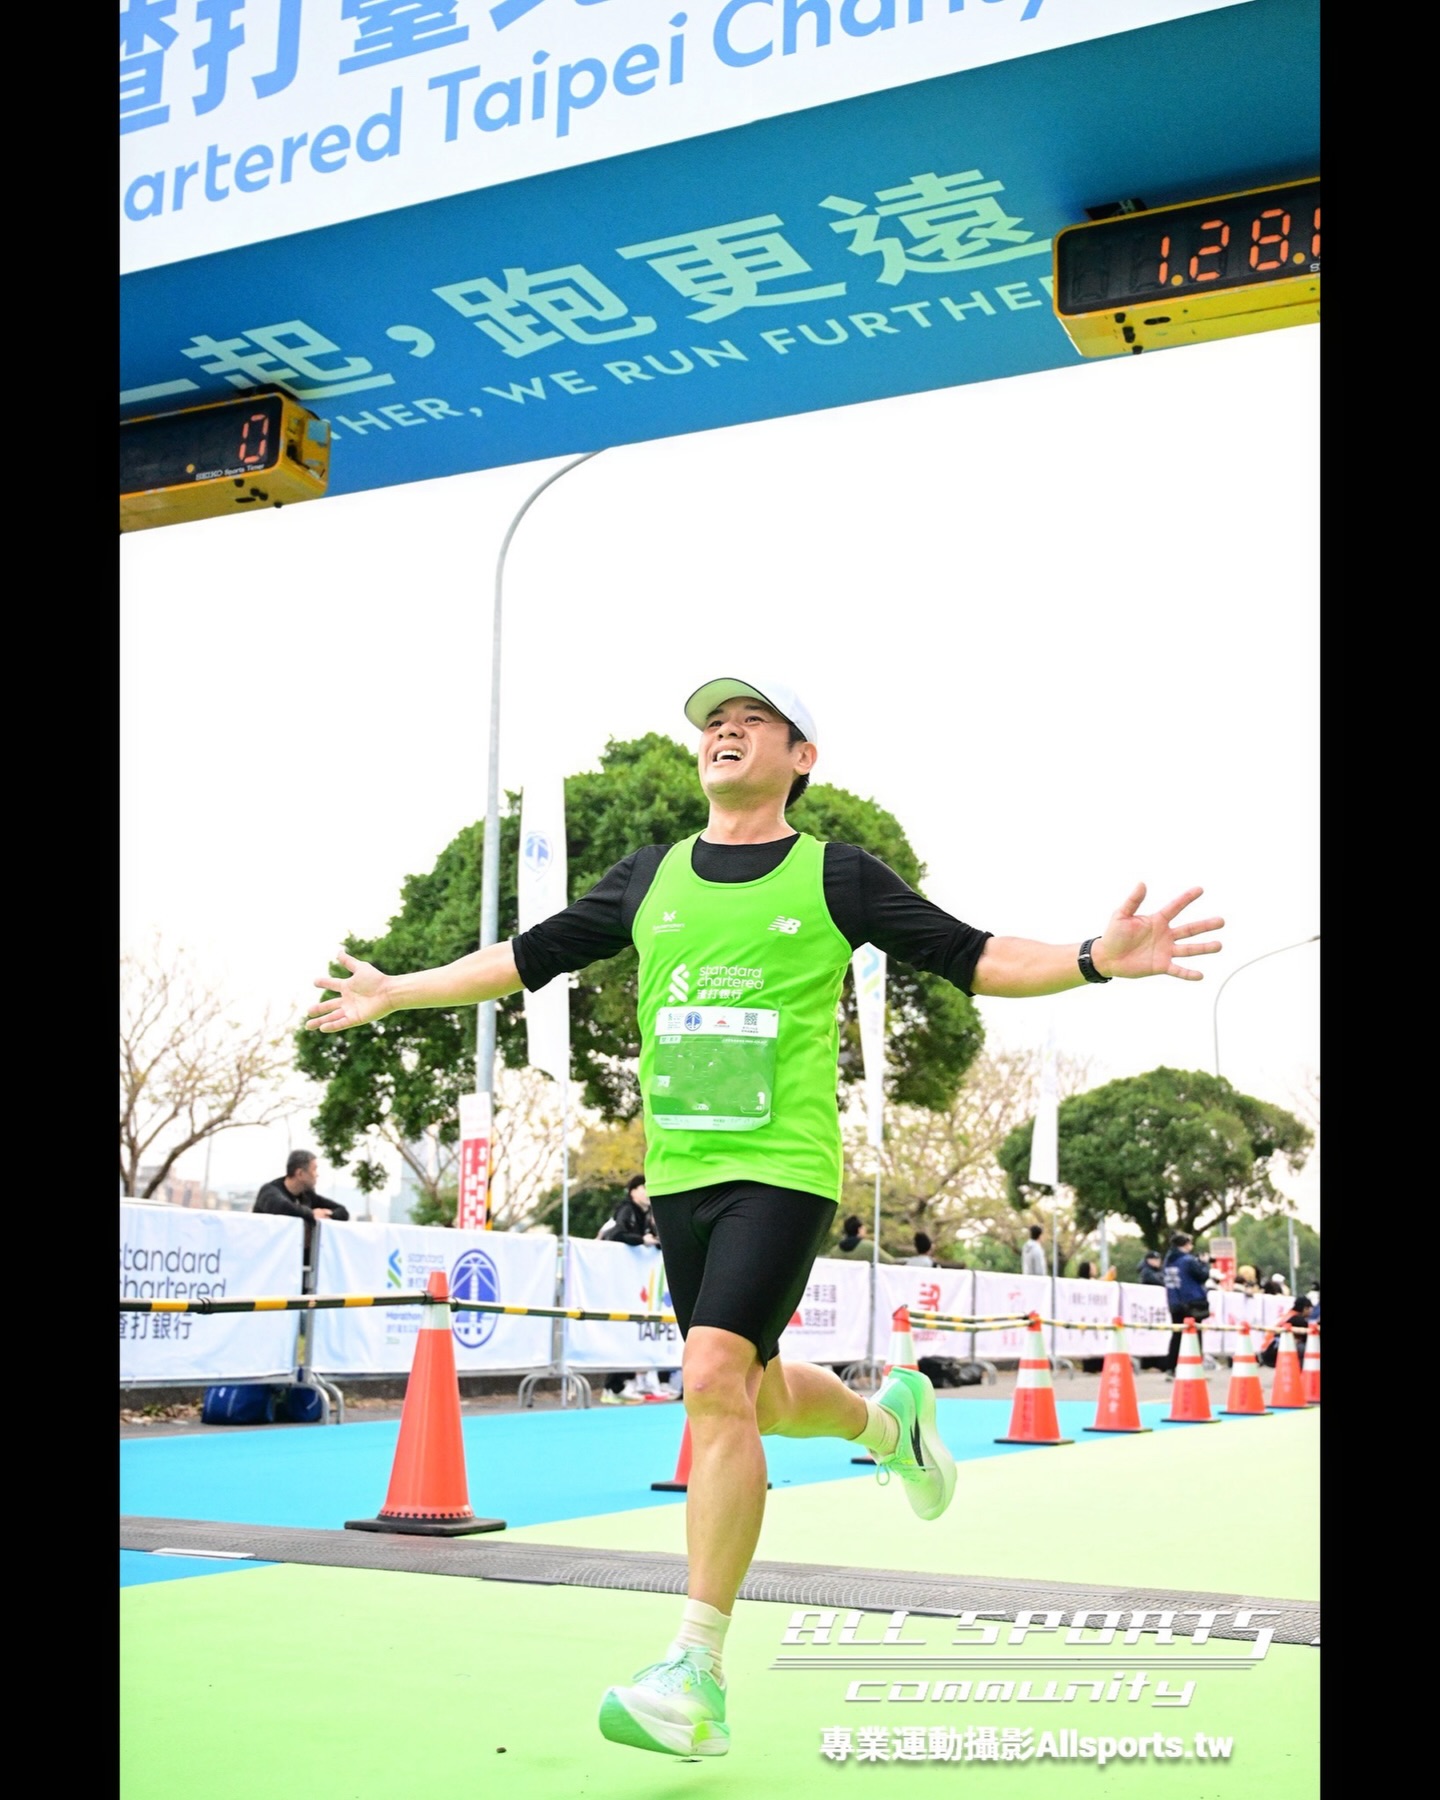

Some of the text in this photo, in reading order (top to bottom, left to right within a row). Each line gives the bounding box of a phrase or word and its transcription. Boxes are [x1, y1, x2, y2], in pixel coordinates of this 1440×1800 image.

[428, 11, 688, 143] Taipei
[331, 397, 483, 440] HER,
[481, 376, 598, 405] WE
[604, 340, 749, 385] RUN
[239, 413, 269, 464] 0
[195, 463, 265, 481] SEIKO Sports Timer
[697, 975, 765, 990] chartered
[699, 965, 763, 978] standard
[120, 1243, 221, 1274] tandard
[120, 1275, 227, 1299] hartered
